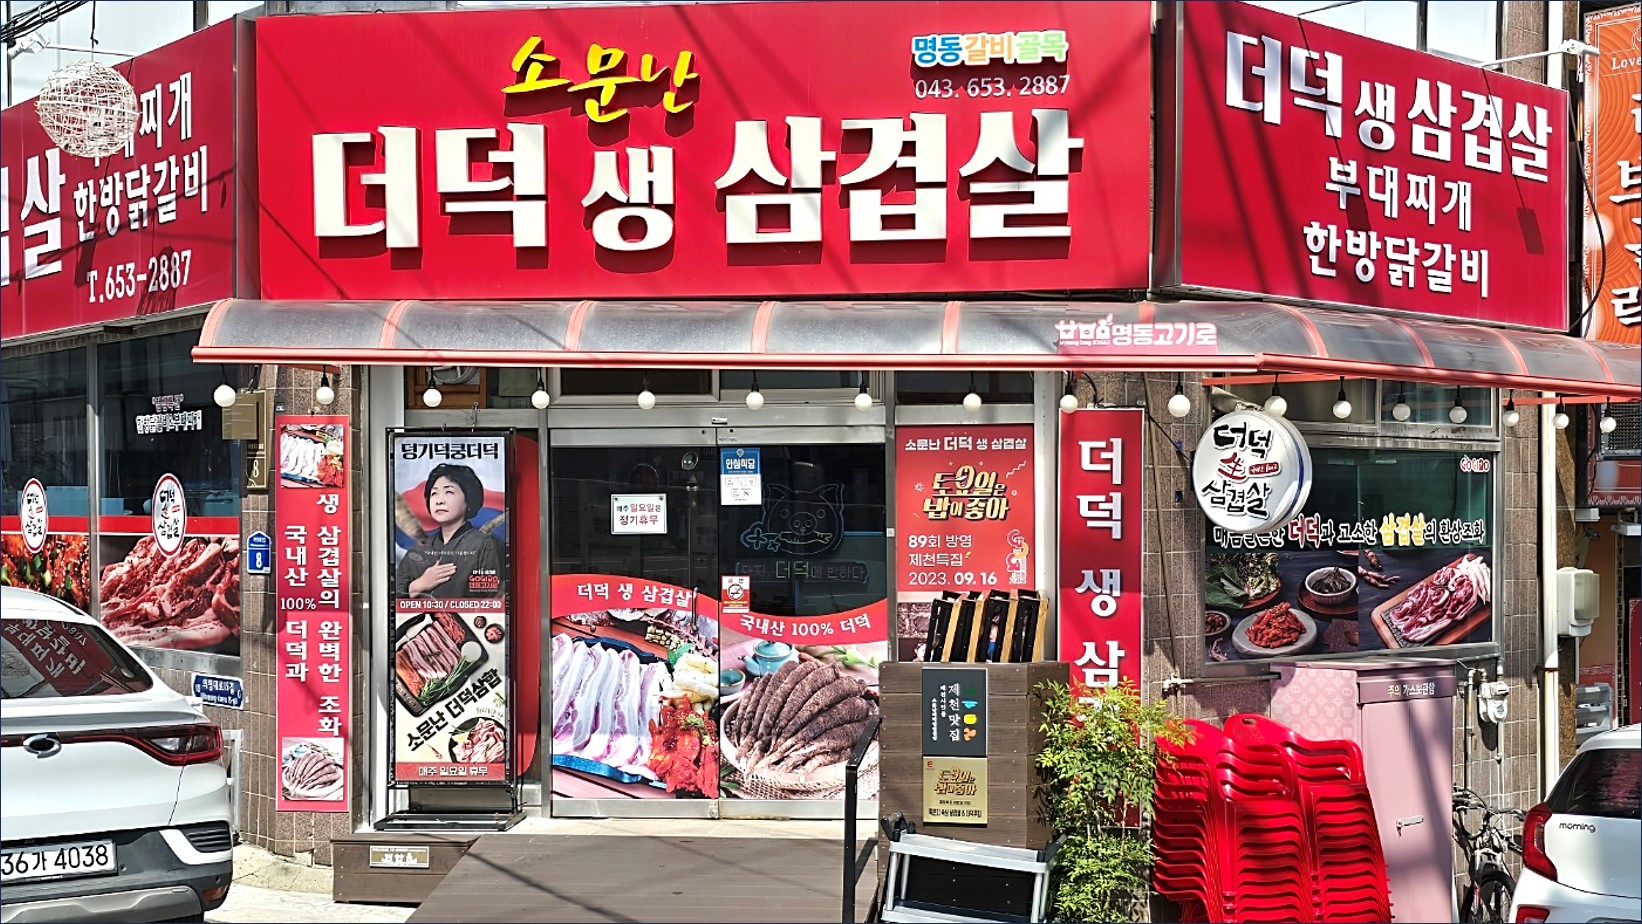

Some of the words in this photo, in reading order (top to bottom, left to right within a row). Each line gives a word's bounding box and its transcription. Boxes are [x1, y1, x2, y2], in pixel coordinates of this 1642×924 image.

[911, 31, 1068, 68] 명동갈비골목
[502, 35, 700, 122] 소문난
[916, 79, 960, 99] 043.
[967, 78, 1011, 98] 653.
[1020, 75, 1070, 97] 2887
[1226, 31, 1343, 138] 더덕
[1355, 81, 1396, 151] 생
[1407, 78, 1552, 183] 삼겹살
[73, 146, 208, 243] 한방닭갈비
[313, 123, 548, 249] 더덕
[582, 145, 676, 252] 생
[714, 109, 1085, 244] 삼겹살
[1326, 157, 1471, 232] 부대찌개
[87, 250, 192, 304] T.653-2887
[1303, 221, 1488, 298] 한방닭갈비
[1112, 322, 1217, 346] 명동고기로
[401, 443, 499, 460] 덩기덕쿵더덕
[944, 436, 972, 450] 더덕
[976, 438, 987, 450] 생
[991, 438, 1026, 450] 삼겹살
[1213, 421, 1271, 458] 더덕
[253, 460, 259, 477] 8
[316, 493, 340, 514] 생
[1076, 437, 1122, 540] 더덕
[1201, 480, 1271, 516] 삼겹살
[619, 515, 658, 526] 정기휴무
[1288, 513, 1335, 548] 더덕과
[1337, 518, 1377, 545] 고소한
[1379, 512, 1437, 546] 삼겹살의
[284, 524, 308, 587] 국내산
[908, 535, 940, 548] 89회
[945, 535, 972, 548] 방영
[256, 552, 262, 568] 8
[317, 525, 342, 609] 삼겹살의
[909, 553, 963, 567] 제천특집
[577, 583, 609, 600] 더덕
[617, 583, 633, 600] 생
[641, 585, 693, 608] 삼겹살
[908, 572, 951, 585] 2023.
[954, 572, 976, 585] 09.
[980, 572, 997, 585] 16
[1075, 569, 1120, 618] 생
[280, 597, 316, 611] 100%
[400, 601, 421, 609] OPEN
[451, 601, 479, 609] CLOSED
[740, 614, 785, 638] 국내산
[791, 622, 834, 636] 100%
[840, 613, 871, 636] 더덕
[285, 620, 308, 682] 더덕과
[318, 620, 341, 683] 완벽한
[1388, 684, 1401, 697] 주의
[318, 695, 341, 736] 조화
[406, 710, 449, 752] 소문난
[444, 668, 503, 719] 더덕삼합
[949, 683, 960, 741] 제천맛집
[419, 767, 437, 776] 매주
[440, 767, 467, 776] 일요일
[470, 767, 488, 776] 휴무
[1559, 823, 1595, 833] morning
[54, 844, 109, 869] 4038
